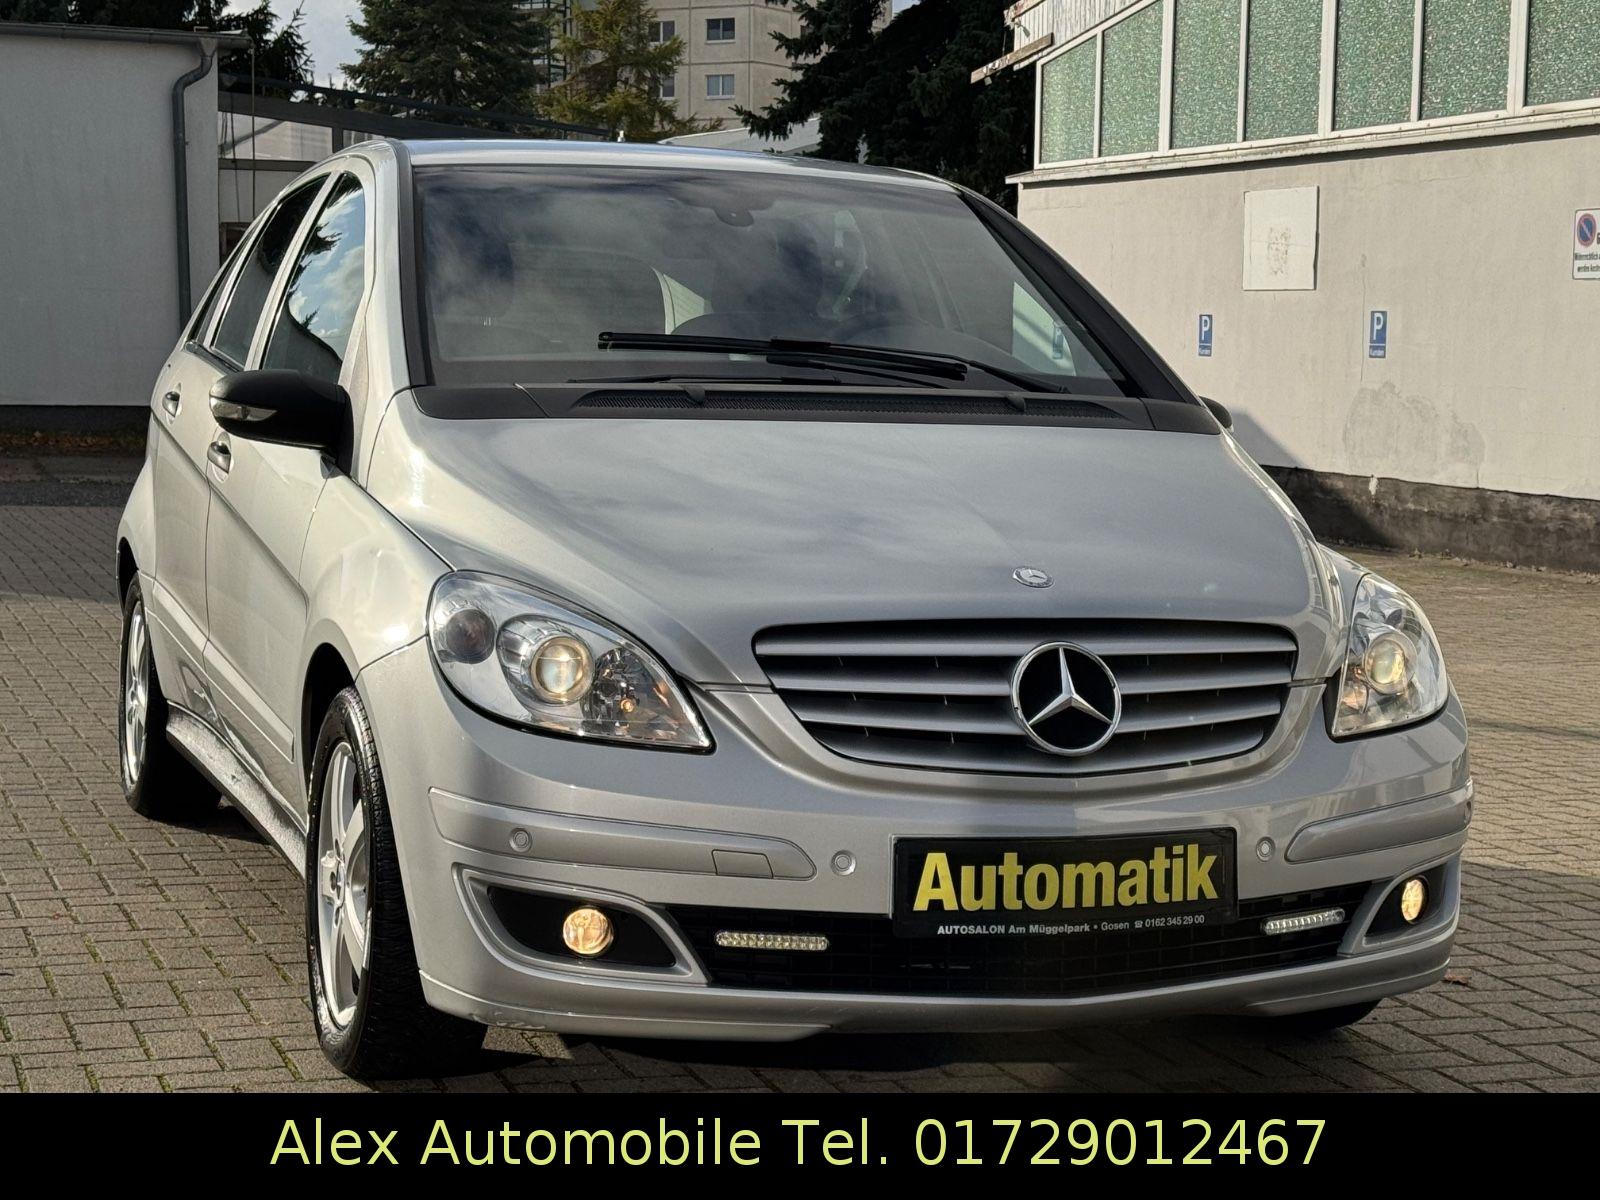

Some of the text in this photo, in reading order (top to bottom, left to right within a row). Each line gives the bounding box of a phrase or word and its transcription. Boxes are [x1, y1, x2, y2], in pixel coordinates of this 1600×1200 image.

[1202, 315, 1210, 341] P
[1373, 312, 1384, 341] P
[913, 843, 1218, 912] Automatik
[937, 924, 1005, 935] AUTOSALON
[1008, 925, 1026, 934] Am
[1029, 923, 1090, 935] Müggelpark
[1101, 921, 1130, 931] Gosen
